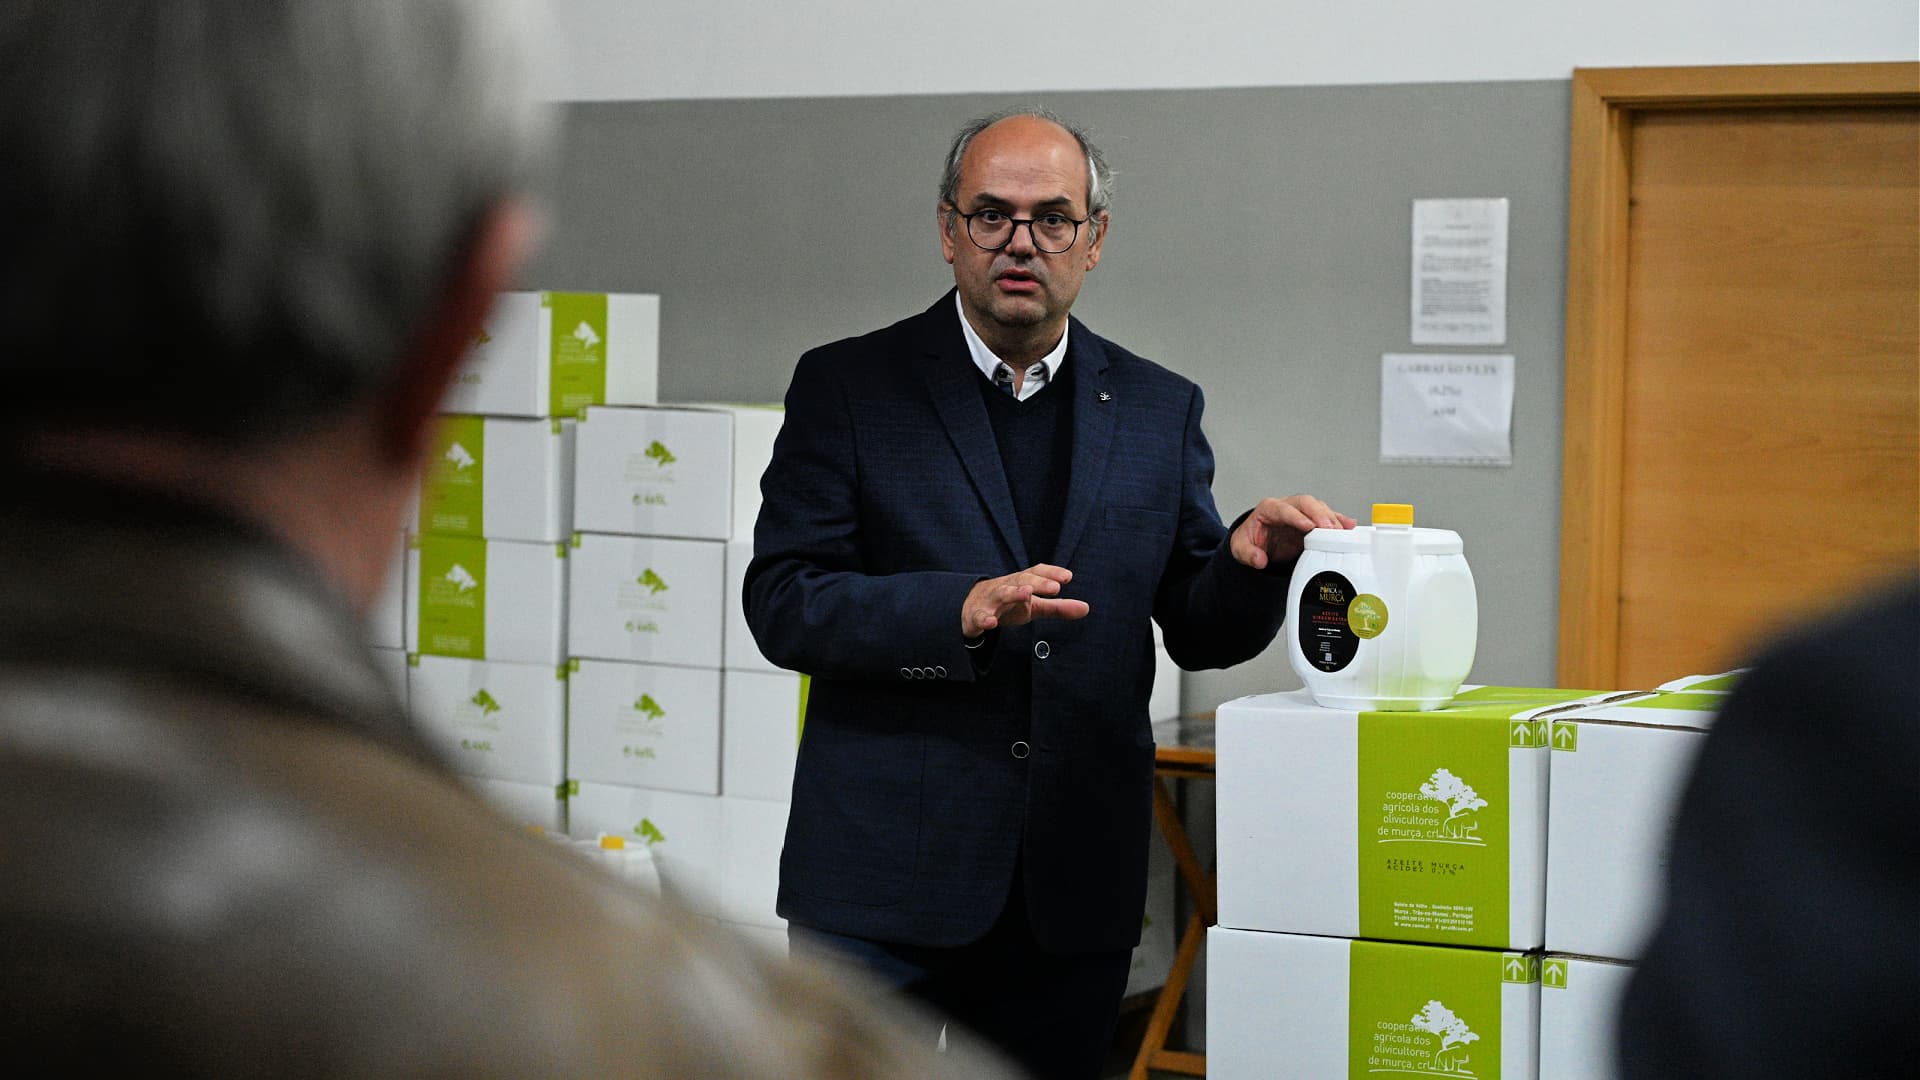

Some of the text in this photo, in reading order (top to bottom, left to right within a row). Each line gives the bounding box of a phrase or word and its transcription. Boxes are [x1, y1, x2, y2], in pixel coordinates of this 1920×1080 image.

[1386, 791, 1439, 802] coopera
[1383, 802, 1440, 814] agrícola dos
[1383, 814, 1440, 826] olivicultores
[1377, 826, 1389, 836] de
[1391, 828, 1425, 839] murça,
[1387, 865, 1424, 873] ACIDEZ
[1431, 861, 1465, 871] MURÇA
[1377, 1021, 1430, 1033] coopera
[1374, 1032, 1431, 1046] agrícola dos
[1374, 1044, 1431, 1058] olivicultores
[1368, 1055, 1380, 1065] de
[1382, 1057, 1415, 1070] murça,
